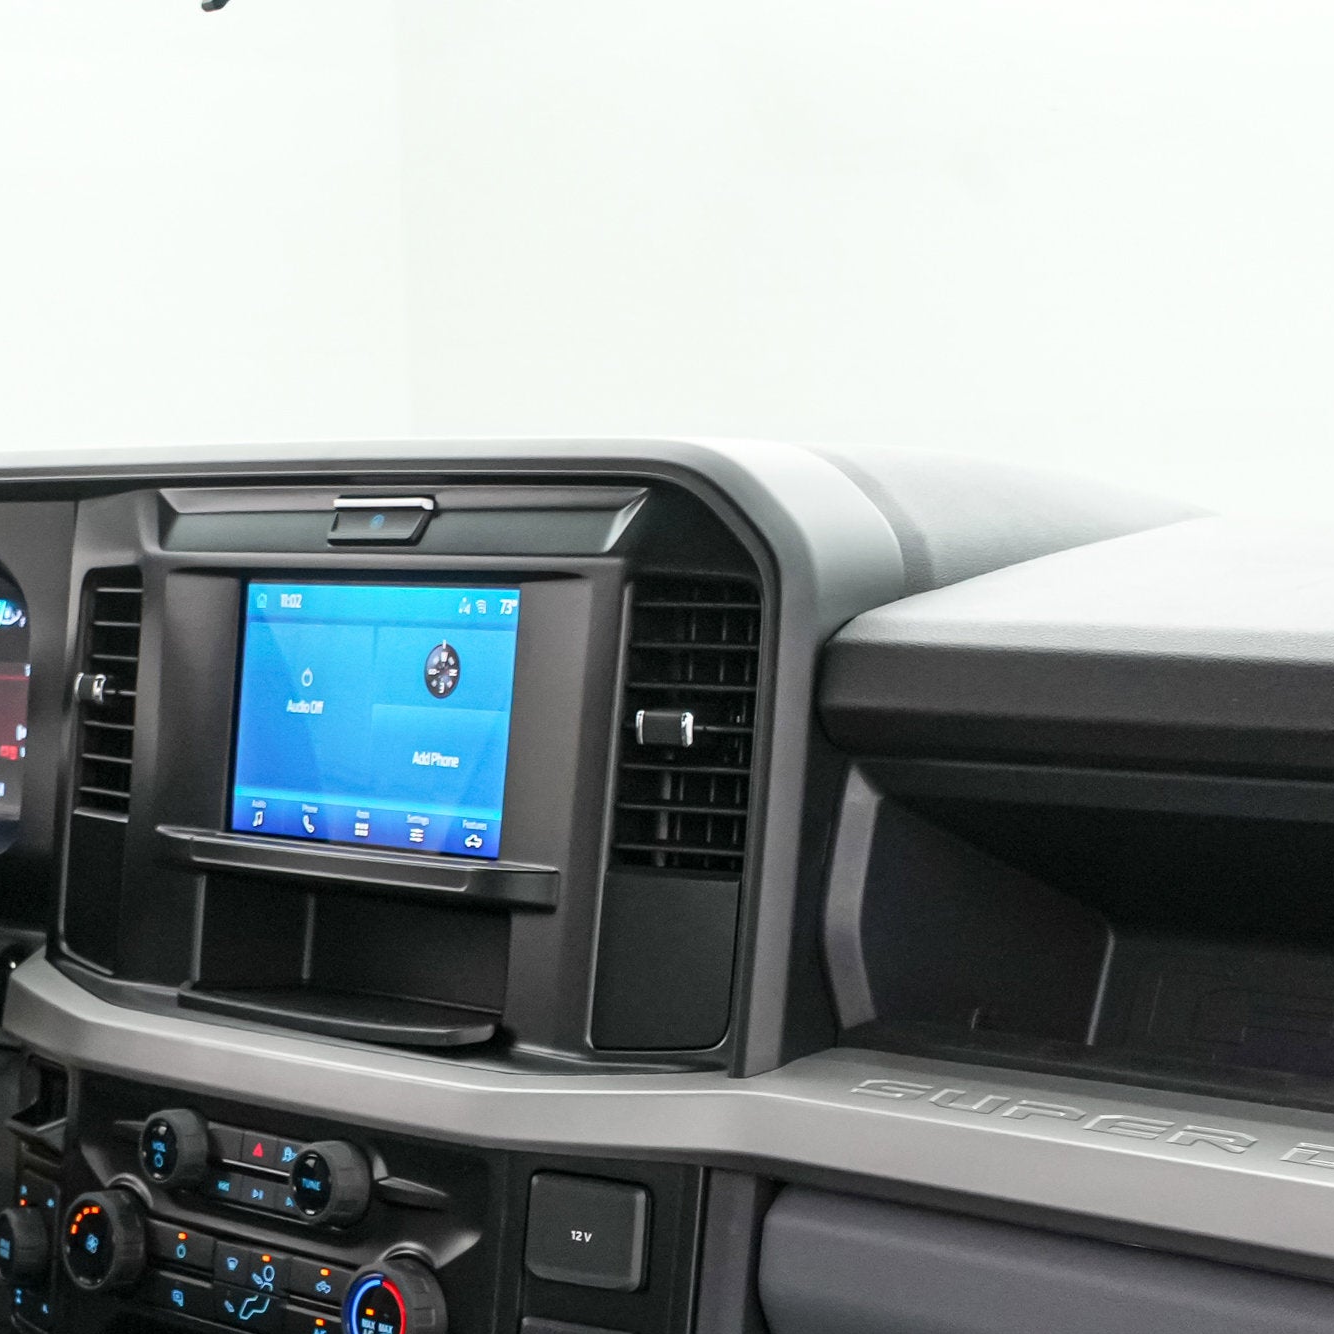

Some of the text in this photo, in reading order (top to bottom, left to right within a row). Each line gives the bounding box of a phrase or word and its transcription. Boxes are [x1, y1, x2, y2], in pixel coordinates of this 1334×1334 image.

[286, 698, 324, 714] Audio Off
[412, 751, 459, 768] Add Phone
[850, 1078, 1261, 1155] SUPER
[301, 1177, 322, 1191] TUNE
[361, 1318, 376, 1330] MAX
